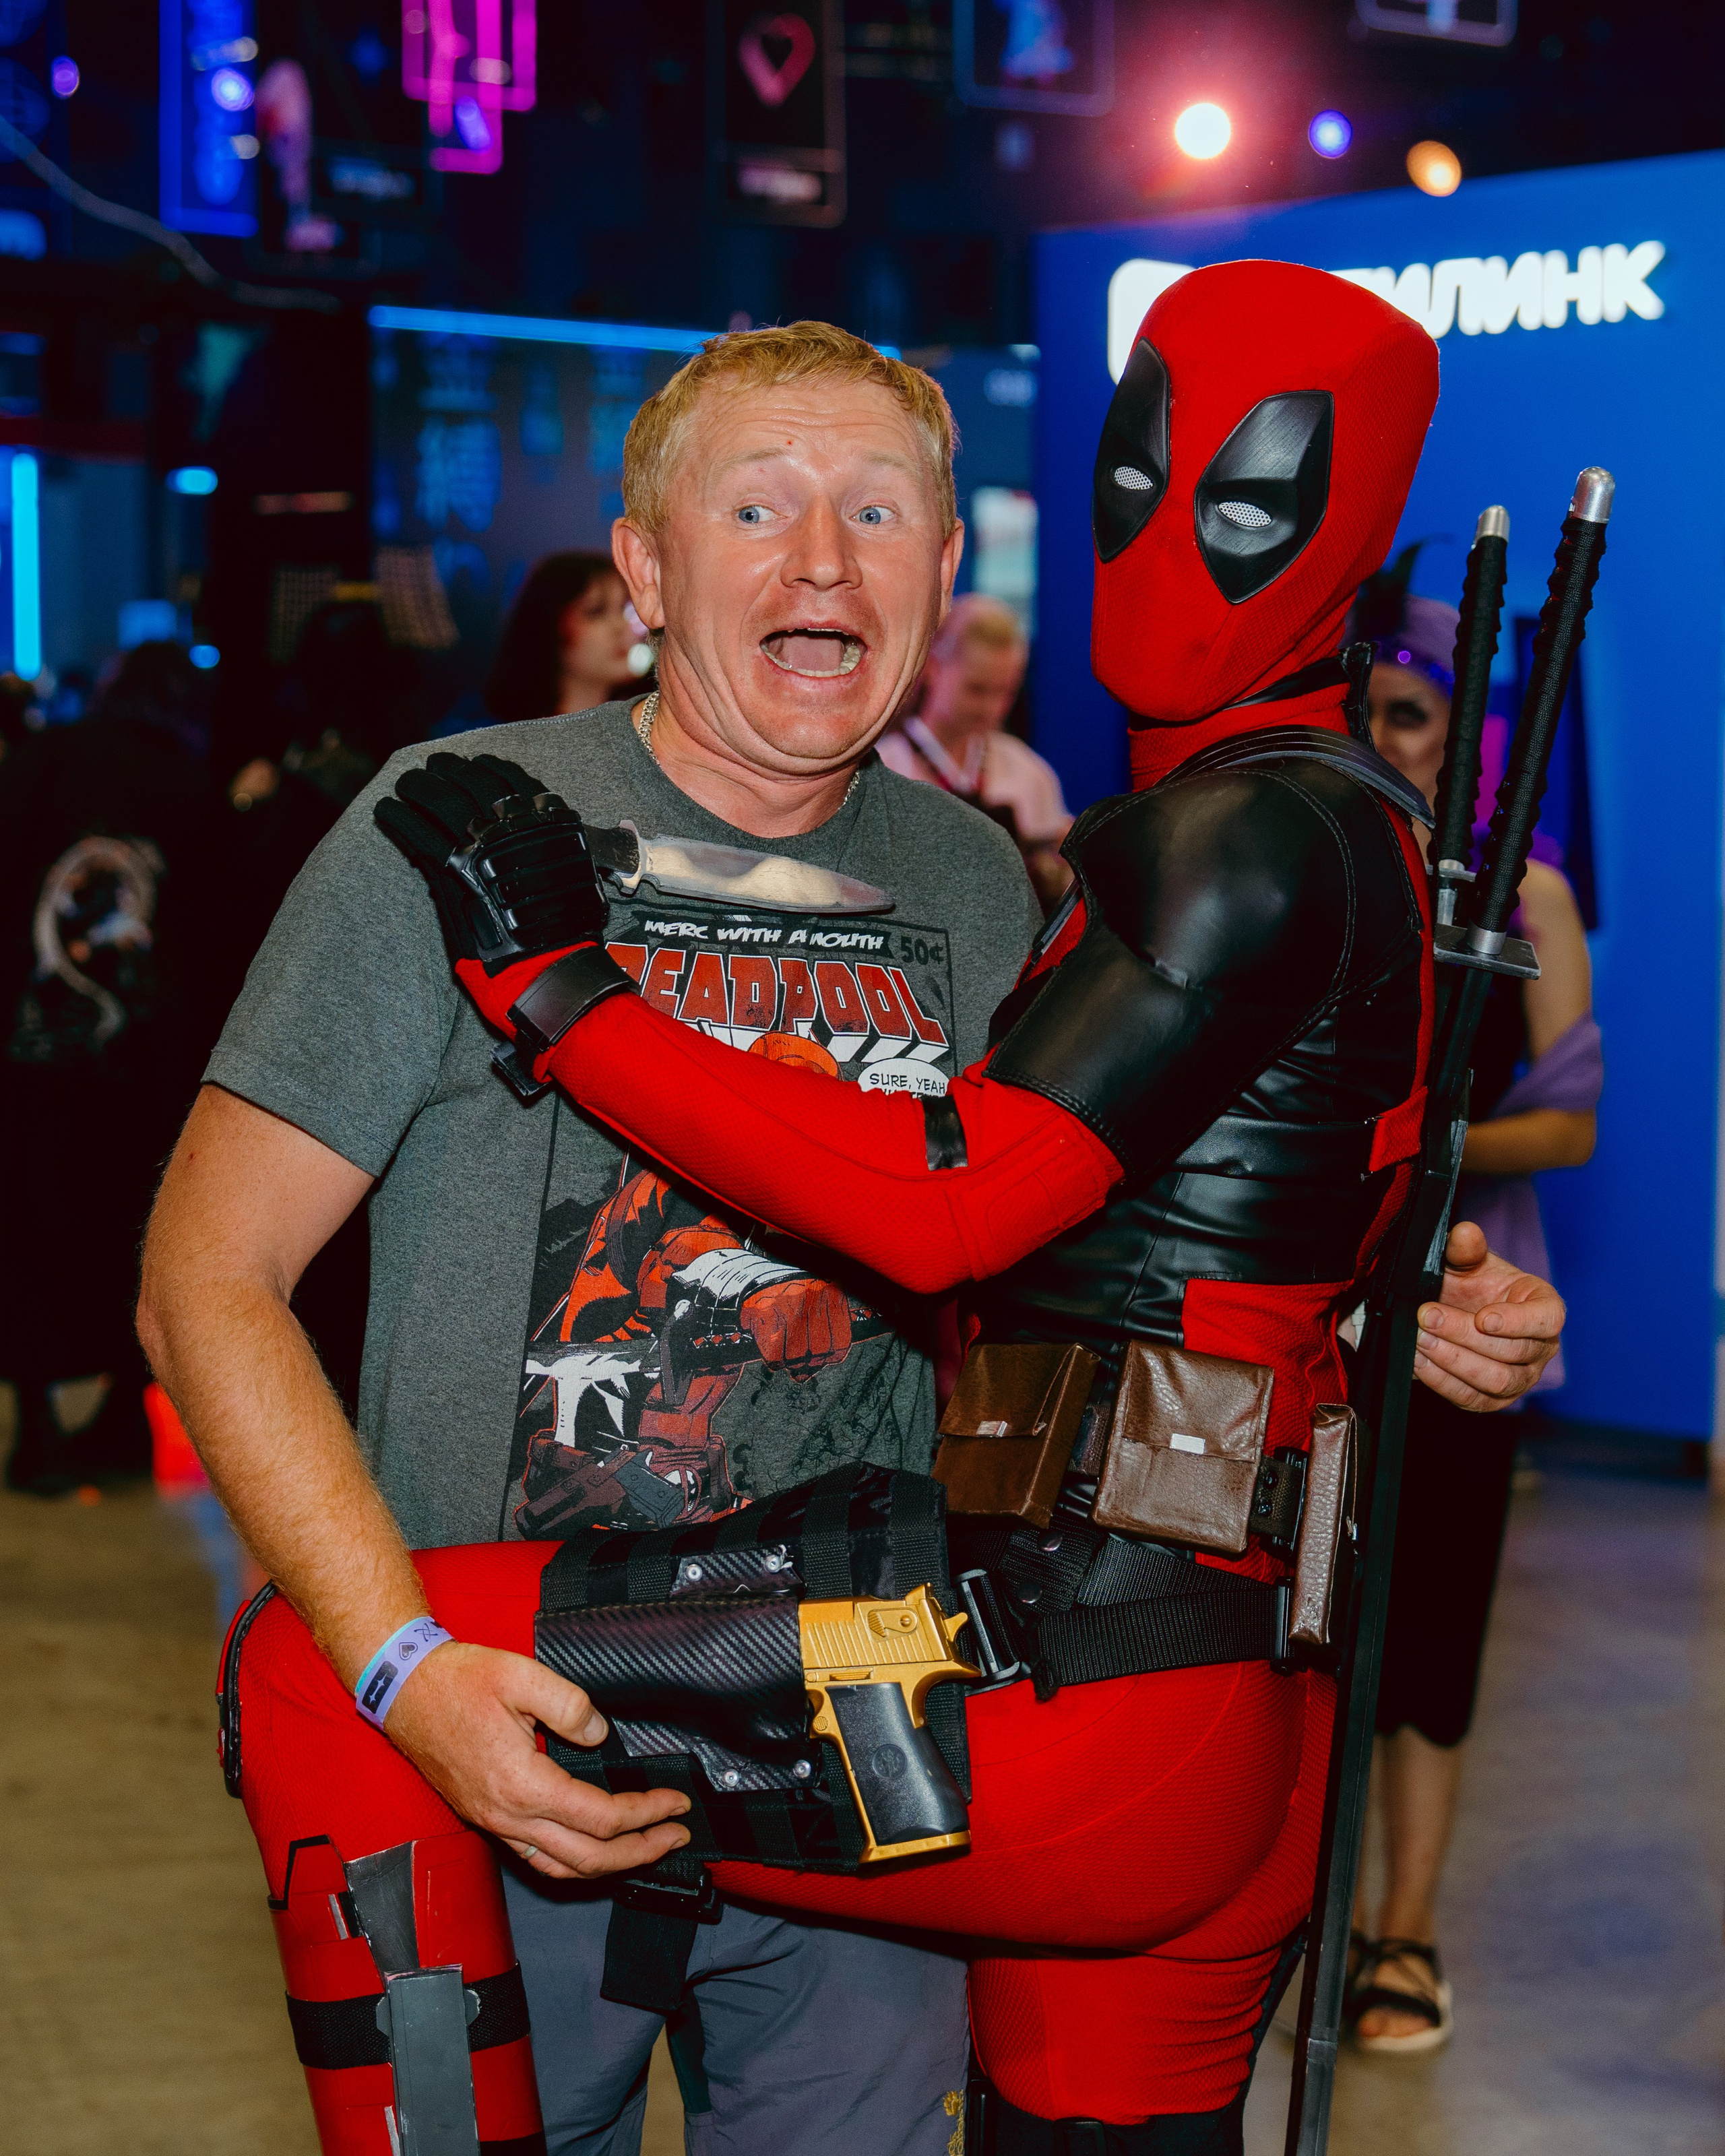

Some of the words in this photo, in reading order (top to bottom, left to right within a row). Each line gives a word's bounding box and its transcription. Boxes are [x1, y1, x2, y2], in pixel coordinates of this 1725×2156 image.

[1325, 240, 1666, 340] ИЛИНК
[644, 920, 709, 939] MERC
[717, 927, 783, 943] WITH
[788, 930, 808, 945] A
[869, 1073, 911, 1089] SURE,
